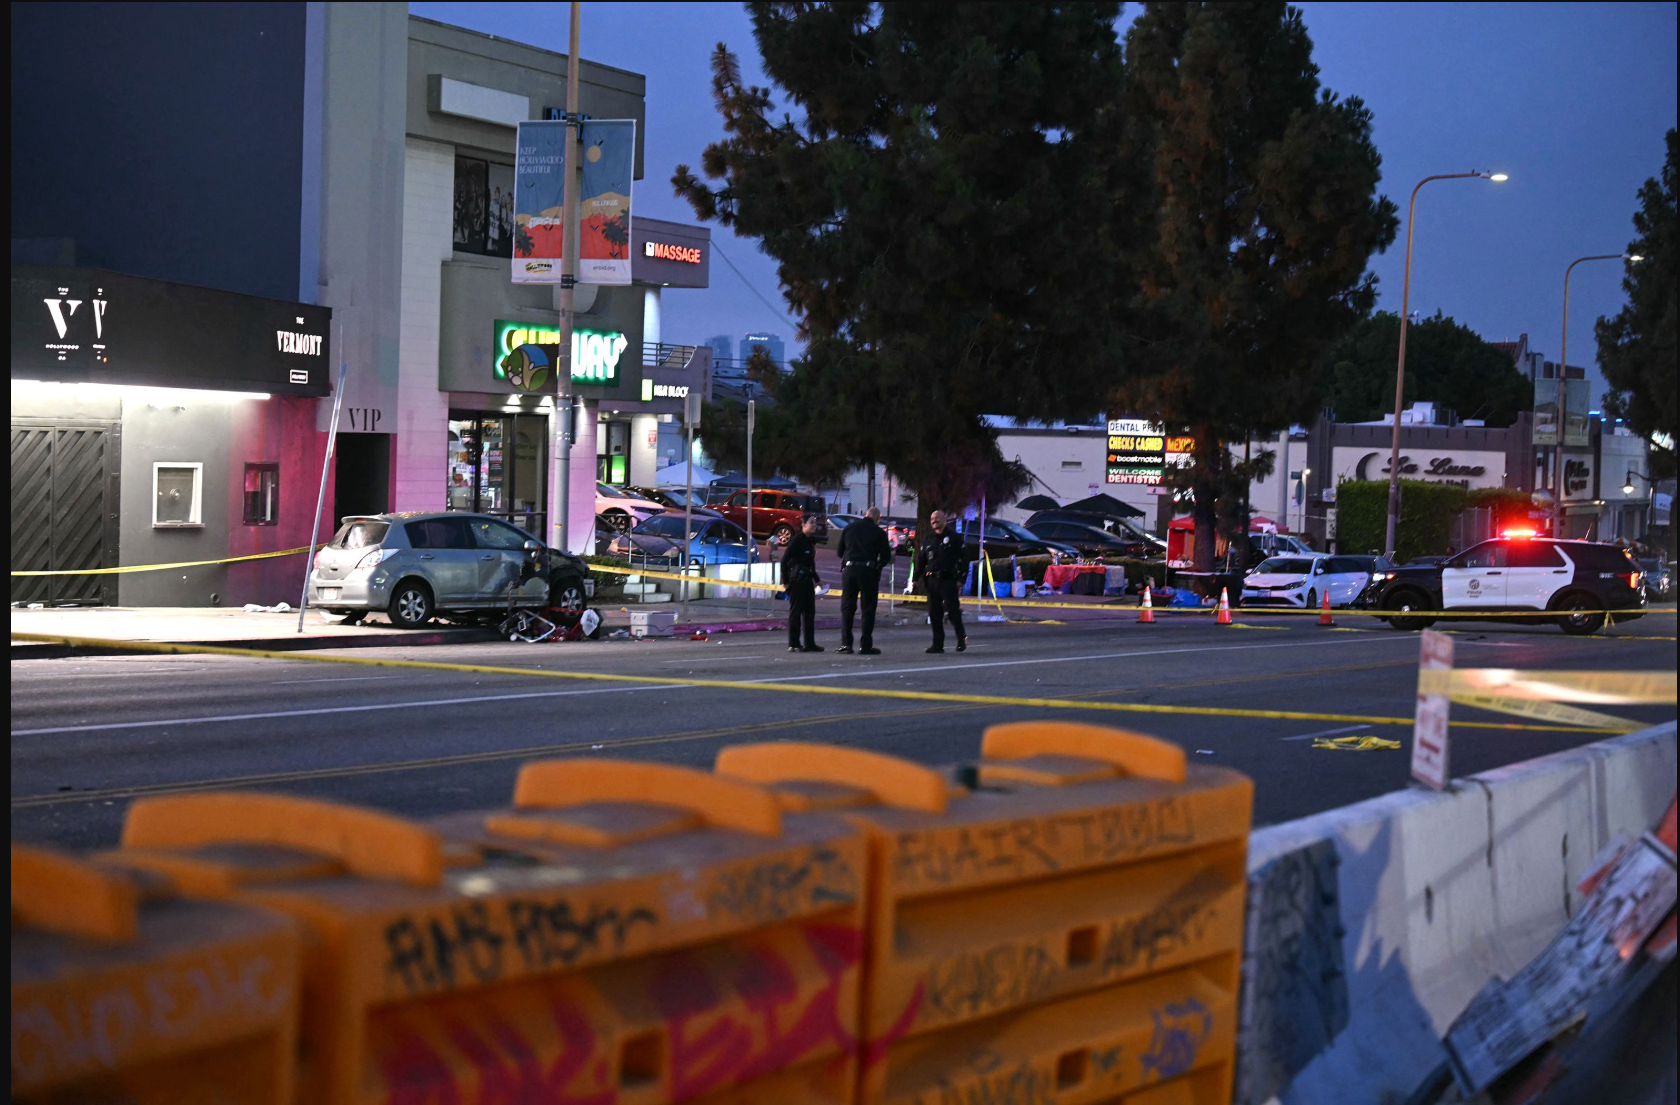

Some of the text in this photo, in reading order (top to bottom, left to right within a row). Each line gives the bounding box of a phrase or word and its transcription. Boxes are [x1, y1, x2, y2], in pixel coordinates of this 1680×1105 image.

[520, 147, 536, 155] KEEP
[519, 155, 563, 164] HOLLYWOOD
[519, 165, 551, 174] BEAUTIFUL
[592, 199, 618, 207] HOLLYWOOD
[654, 243, 701, 264] MASSAGE
[43, 298, 83, 339] V
[276, 330, 322, 356] VERMONT
[498, 328, 629, 379] SWAY
[348, 407, 381, 431] VIP
[1109, 422, 1139, 432] DENTAL
[1108, 435, 1163, 451] CHECKS CASHED
[1108, 468, 1162, 476] WELCOME
[1382, 455, 1485, 476] La Luna
[1108, 474, 1163, 484] DENTISTRY
